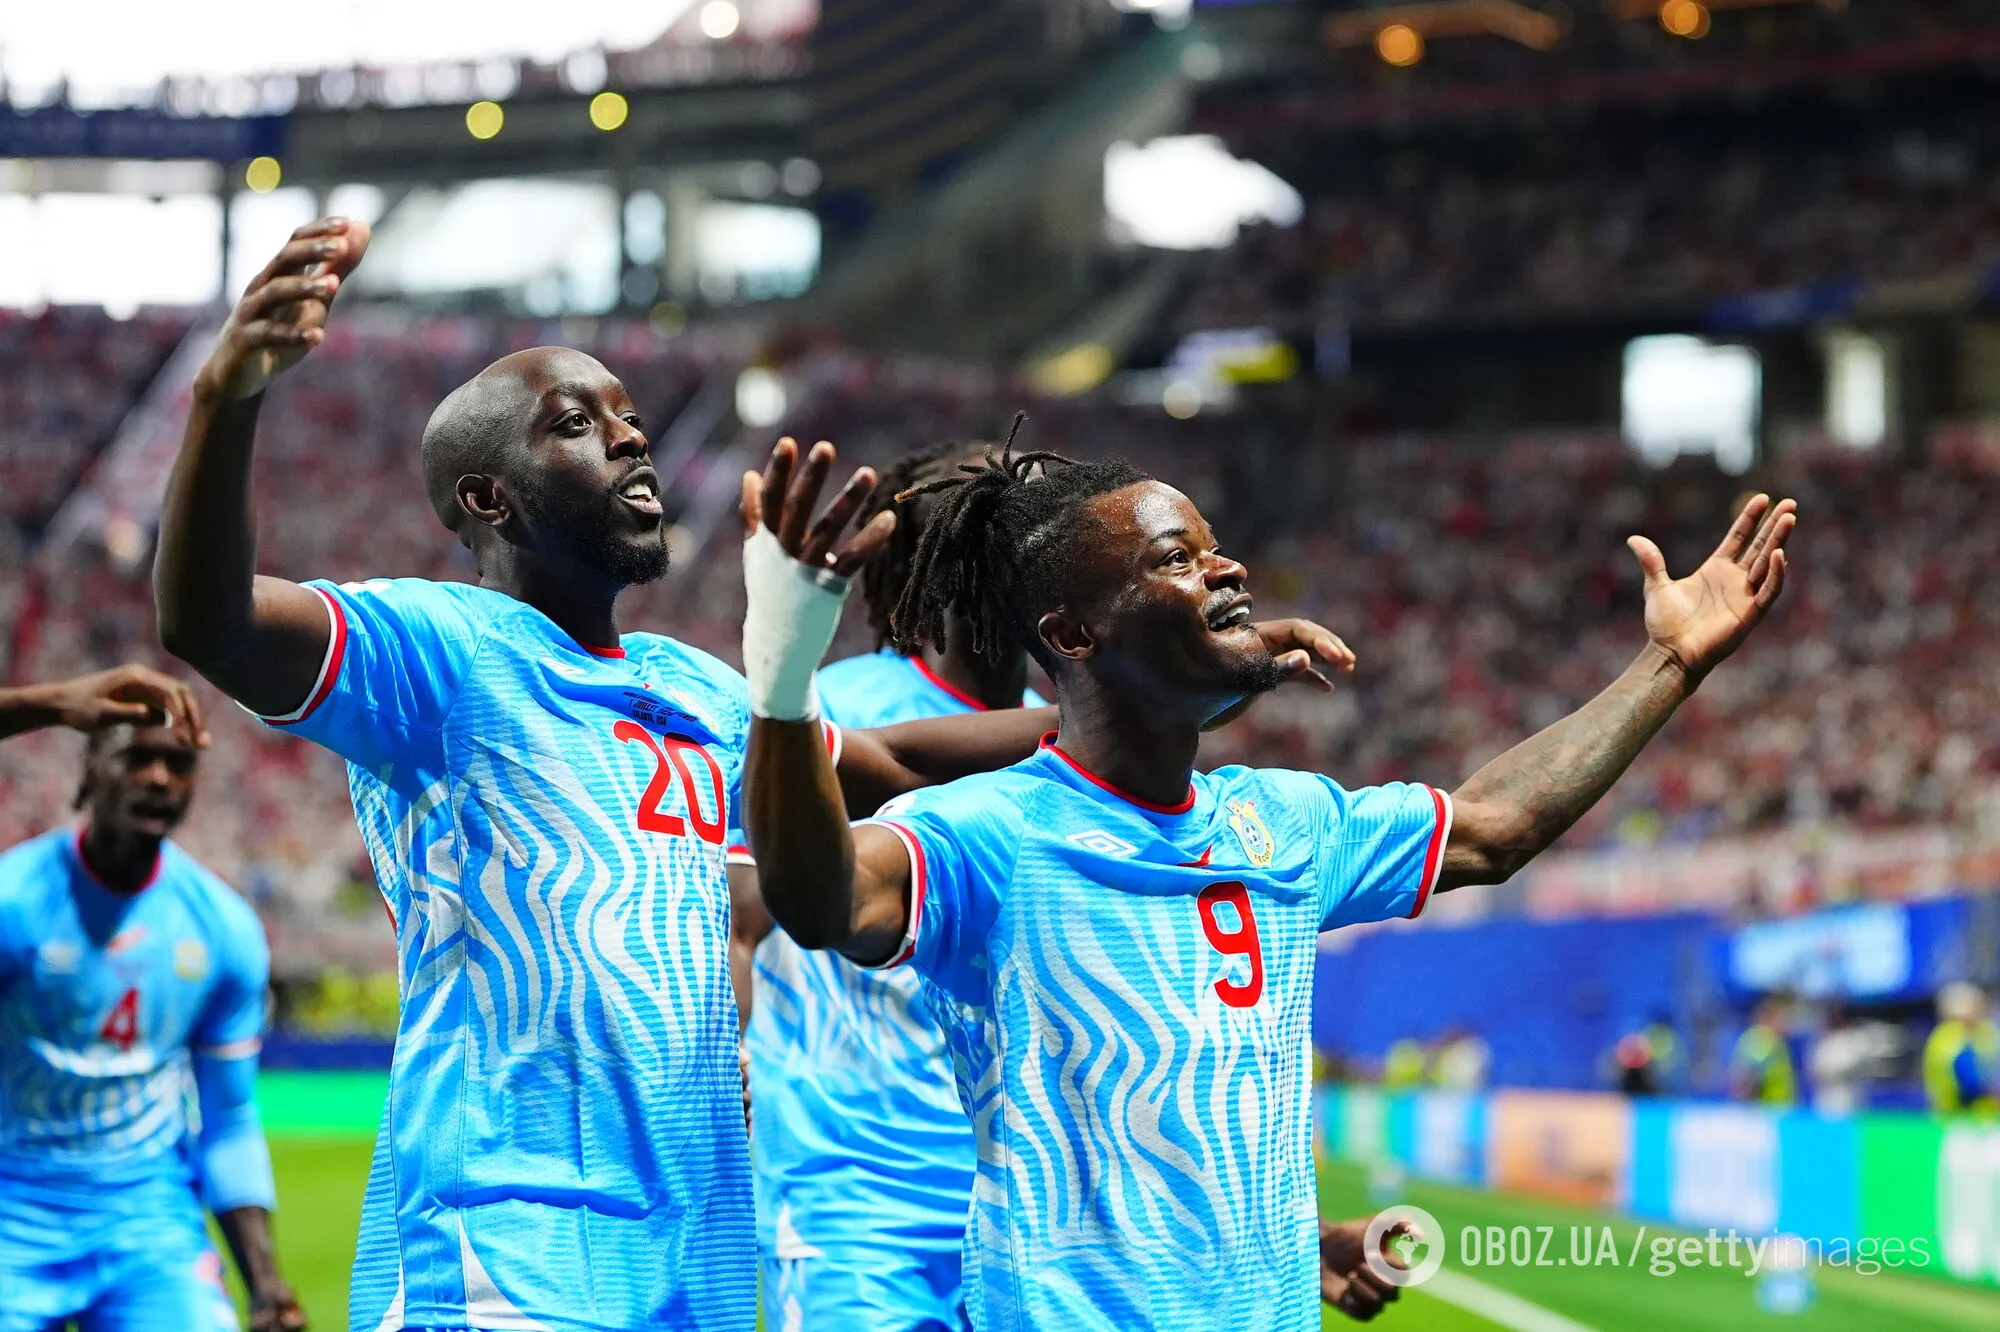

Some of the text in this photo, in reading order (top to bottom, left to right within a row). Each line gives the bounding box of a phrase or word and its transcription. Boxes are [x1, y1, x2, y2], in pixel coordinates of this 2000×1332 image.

[633, 699, 659, 712] JUILLET
[613, 719, 726, 846] 20
[1196, 880, 1264, 1008] 9
[102, 987, 138, 1053] 4
